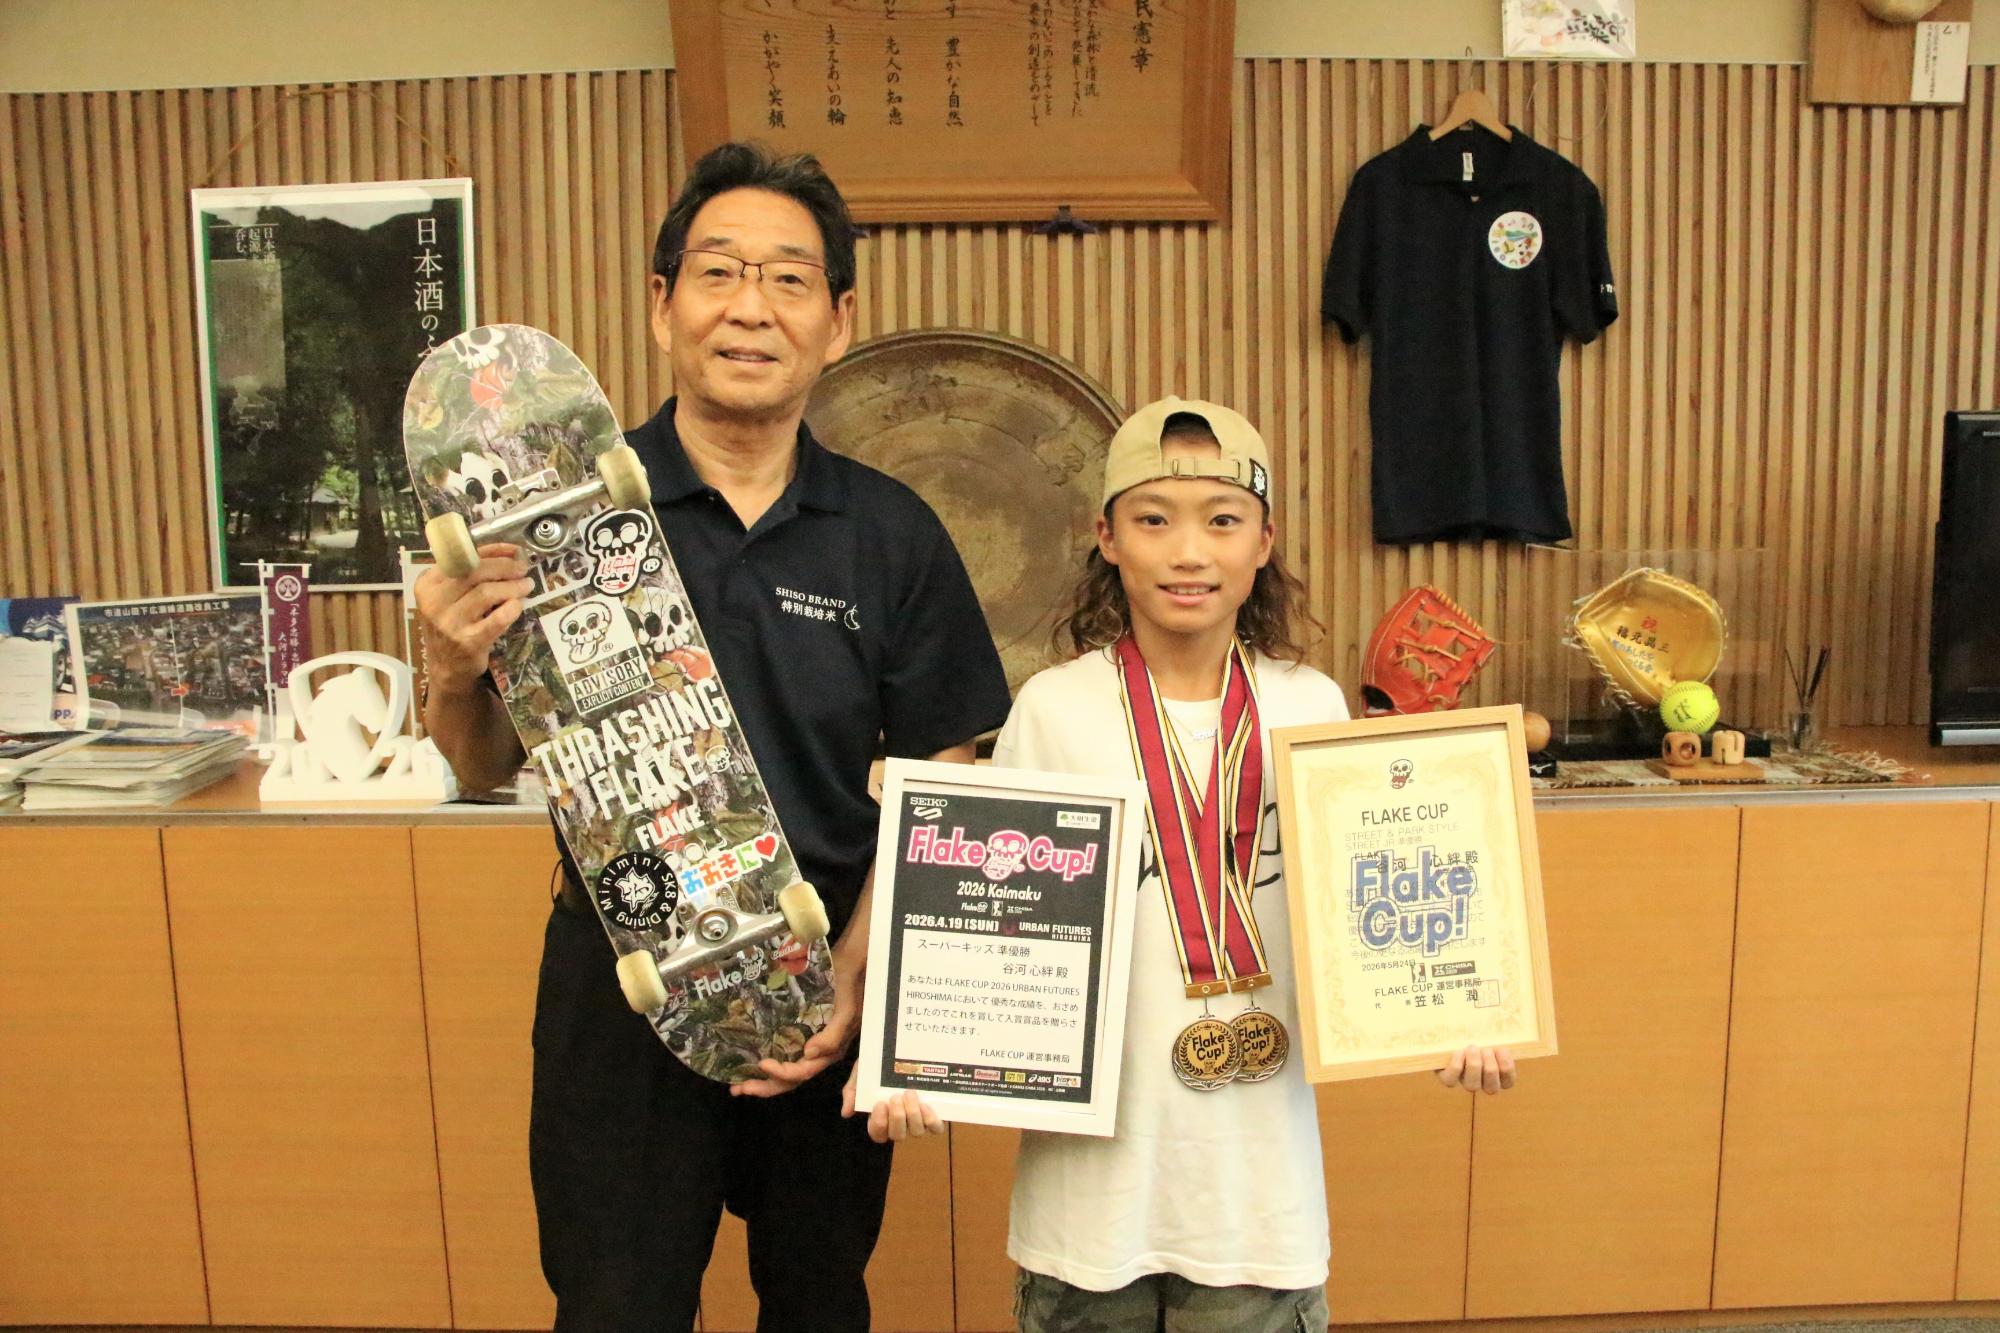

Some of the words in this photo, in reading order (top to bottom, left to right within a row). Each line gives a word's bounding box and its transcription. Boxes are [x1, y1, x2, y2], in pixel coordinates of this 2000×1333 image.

[885, 35, 903, 126] 先人の知恵
[945, 36, 964, 127] 豊かな自然
[775, 586, 806, 602] SHISO
[808, 594, 846, 609] BRAND
[781, 599, 837, 622] 特別栽培米
[573, 658, 645, 700] ADVISORY
[582, 688, 614, 710] EXPLICIT
[613, 677, 646, 698] CONTENT
[531, 678, 732, 798] THRASHING
[589, 736, 709, 821] FLAKE
[909, 796, 948, 808] SEIKO
[1361, 806, 1413, 827] FLAKE
[1416, 803, 1450, 822] CUP
[634, 805, 706, 851] FLAKE
[906, 823, 987, 867] Flake
[1026, 835, 1099, 882] Cup!
[681, 845, 760, 894] おおきに
[1351, 845, 1478, 913] Flake
[957, 880, 986, 897] 2026
[987, 883, 1042, 902] Kaimaku
[904, 913, 962, 930] 2026.4.19
[1018, 921, 1050, 933] URBAN
[1051, 924, 1092, 936] FUTURES
[1358, 895, 1470, 958] Cup!
[996, 945, 1031, 958] 準優勝
[693, 967, 743, 1001] Flake
[908, 974, 943, 986] あなたは
[944, 977, 971, 988] FLAKE
[971, 979, 989, 989] CUP
[990, 980, 1011, 991] 2026
[1012, 982, 1042, 993] URBAN
[1043, 984, 1081, 996] FUTURES
[1374, 986, 1409, 997] FLAKE
[1411, 982, 1434, 993] CUP
[906, 990, 953, 1002] HIROSHIMA
[1192, 1031, 1225, 1051] Flake
[1238, 1023, 1271, 1040] Flake
[980, 1048, 1006, 1059] FLAKE
[1007, 1050, 1025, 1060] CUP
[1196, 1043, 1225, 1061] Cup!
[1242, 1035, 1270, 1053] Cup!
